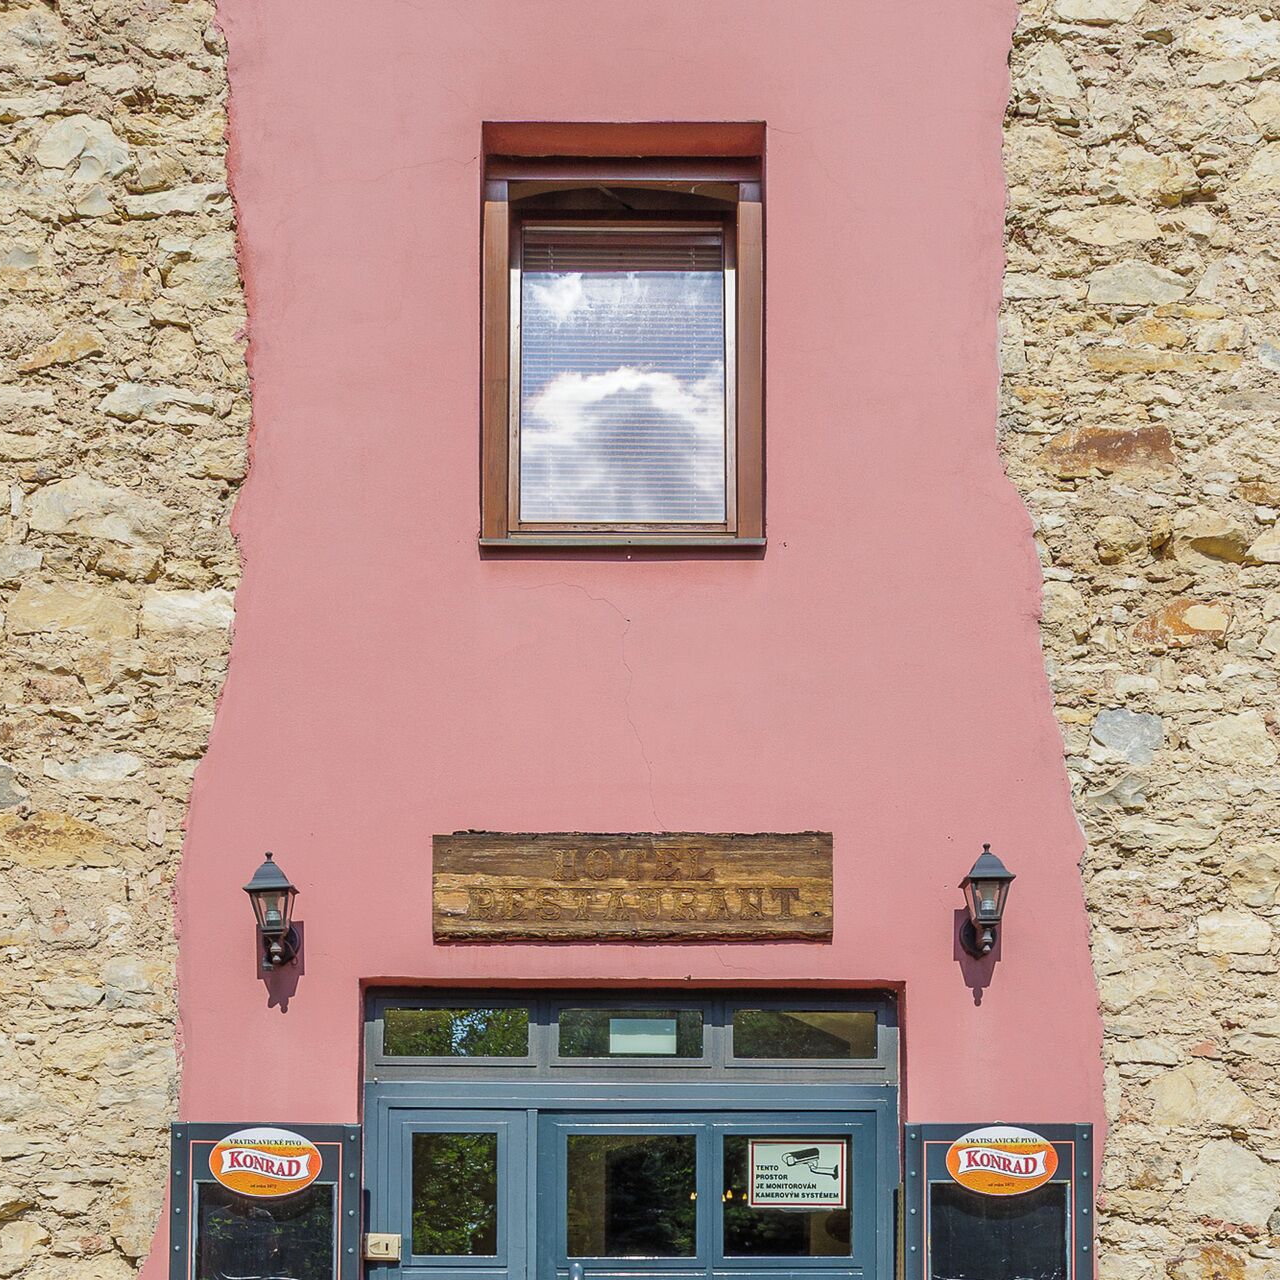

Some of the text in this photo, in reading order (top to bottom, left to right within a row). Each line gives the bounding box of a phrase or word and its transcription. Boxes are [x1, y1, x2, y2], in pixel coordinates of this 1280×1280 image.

[551, 846, 715, 882] HOTEL
[466, 886, 800, 922] RESTAURANT
[229, 1138, 283, 1146] VRATISLAVICKÉ
[966, 1136, 1019, 1144] VRATISLAVICKÉ
[228, 1151, 302, 1177] KONRAD
[966, 1150, 1038, 1175] KONRAD
